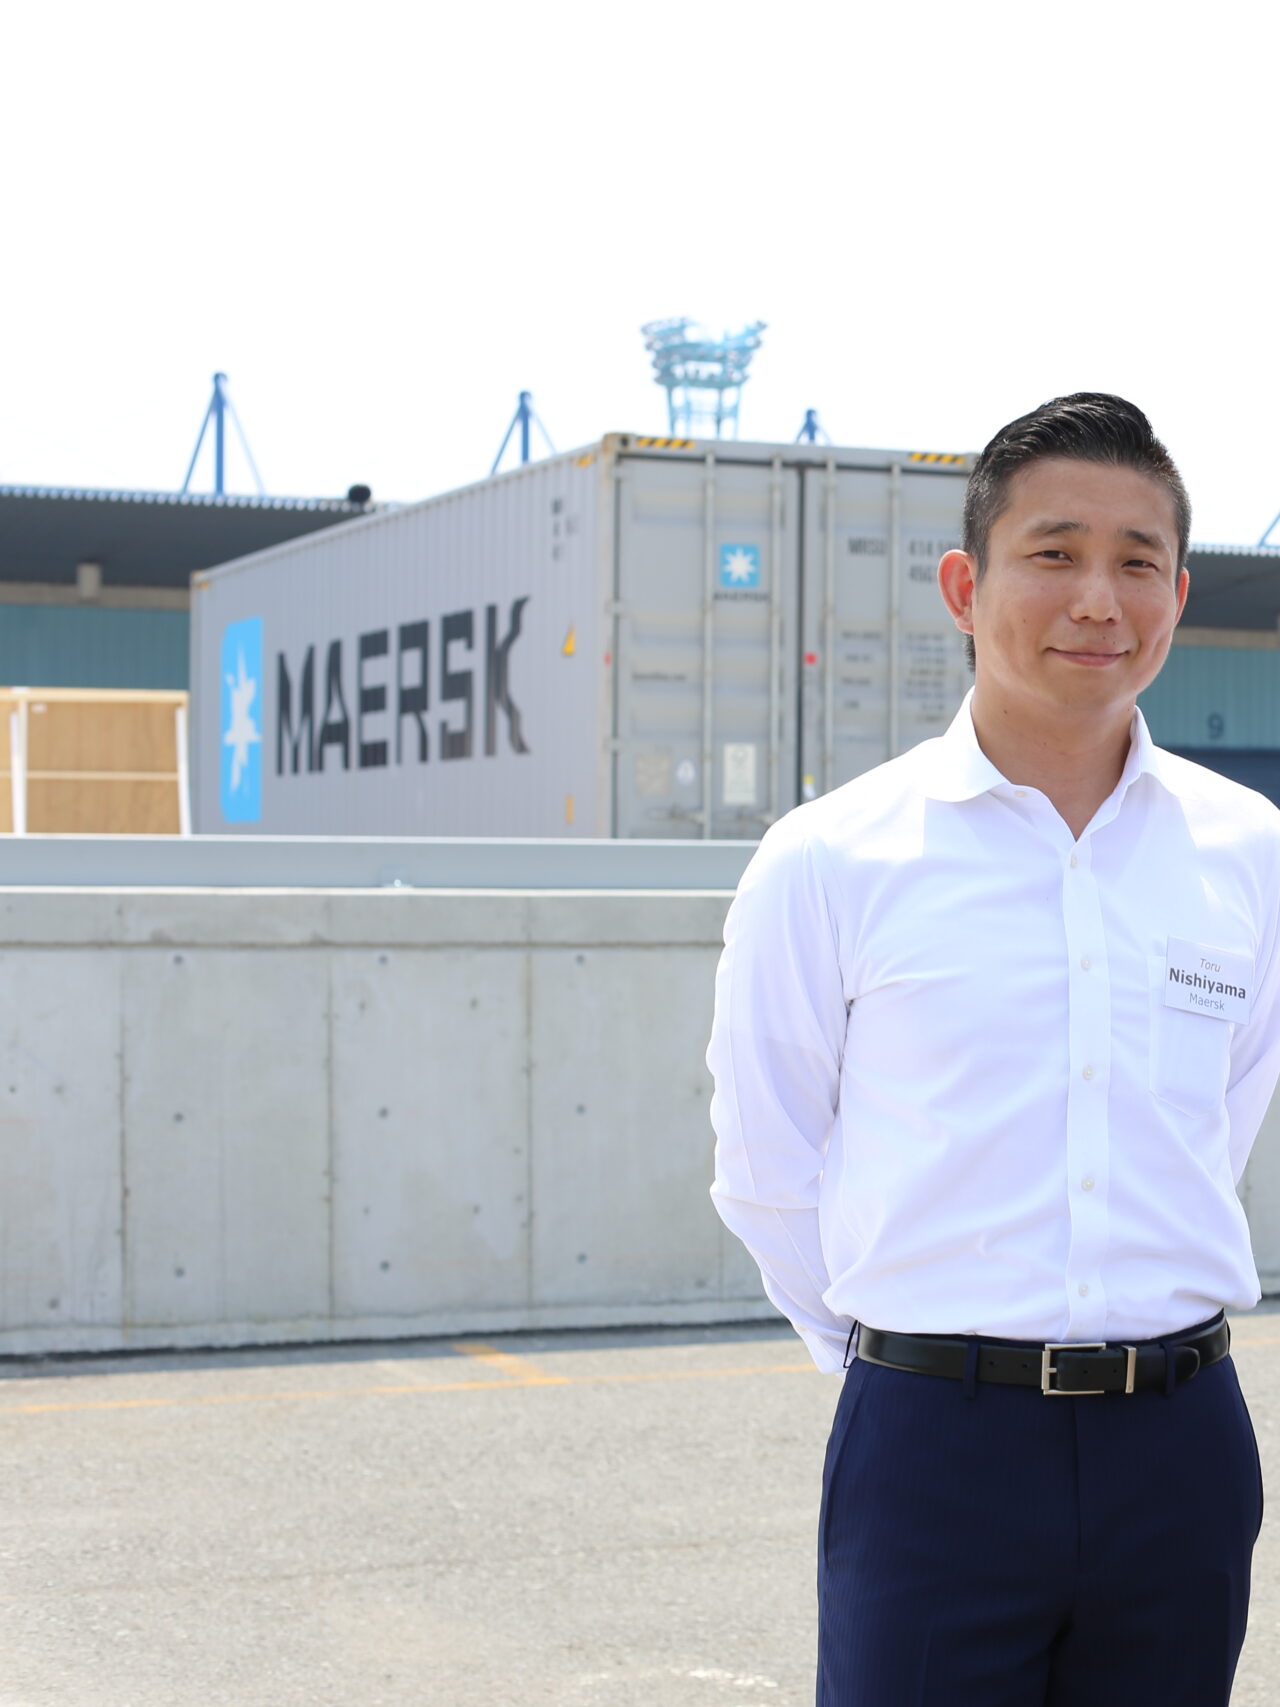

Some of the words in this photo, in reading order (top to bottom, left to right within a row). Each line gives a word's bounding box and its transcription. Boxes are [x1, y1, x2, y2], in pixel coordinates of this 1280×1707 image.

[276, 595, 531, 777] MAERSK
[1207, 712, 1225, 740] 9
[1200, 957, 1221, 973] Toru
[1169, 967, 1247, 999] Nishiyama
[1189, 992, 1225, 1011] Maersk
